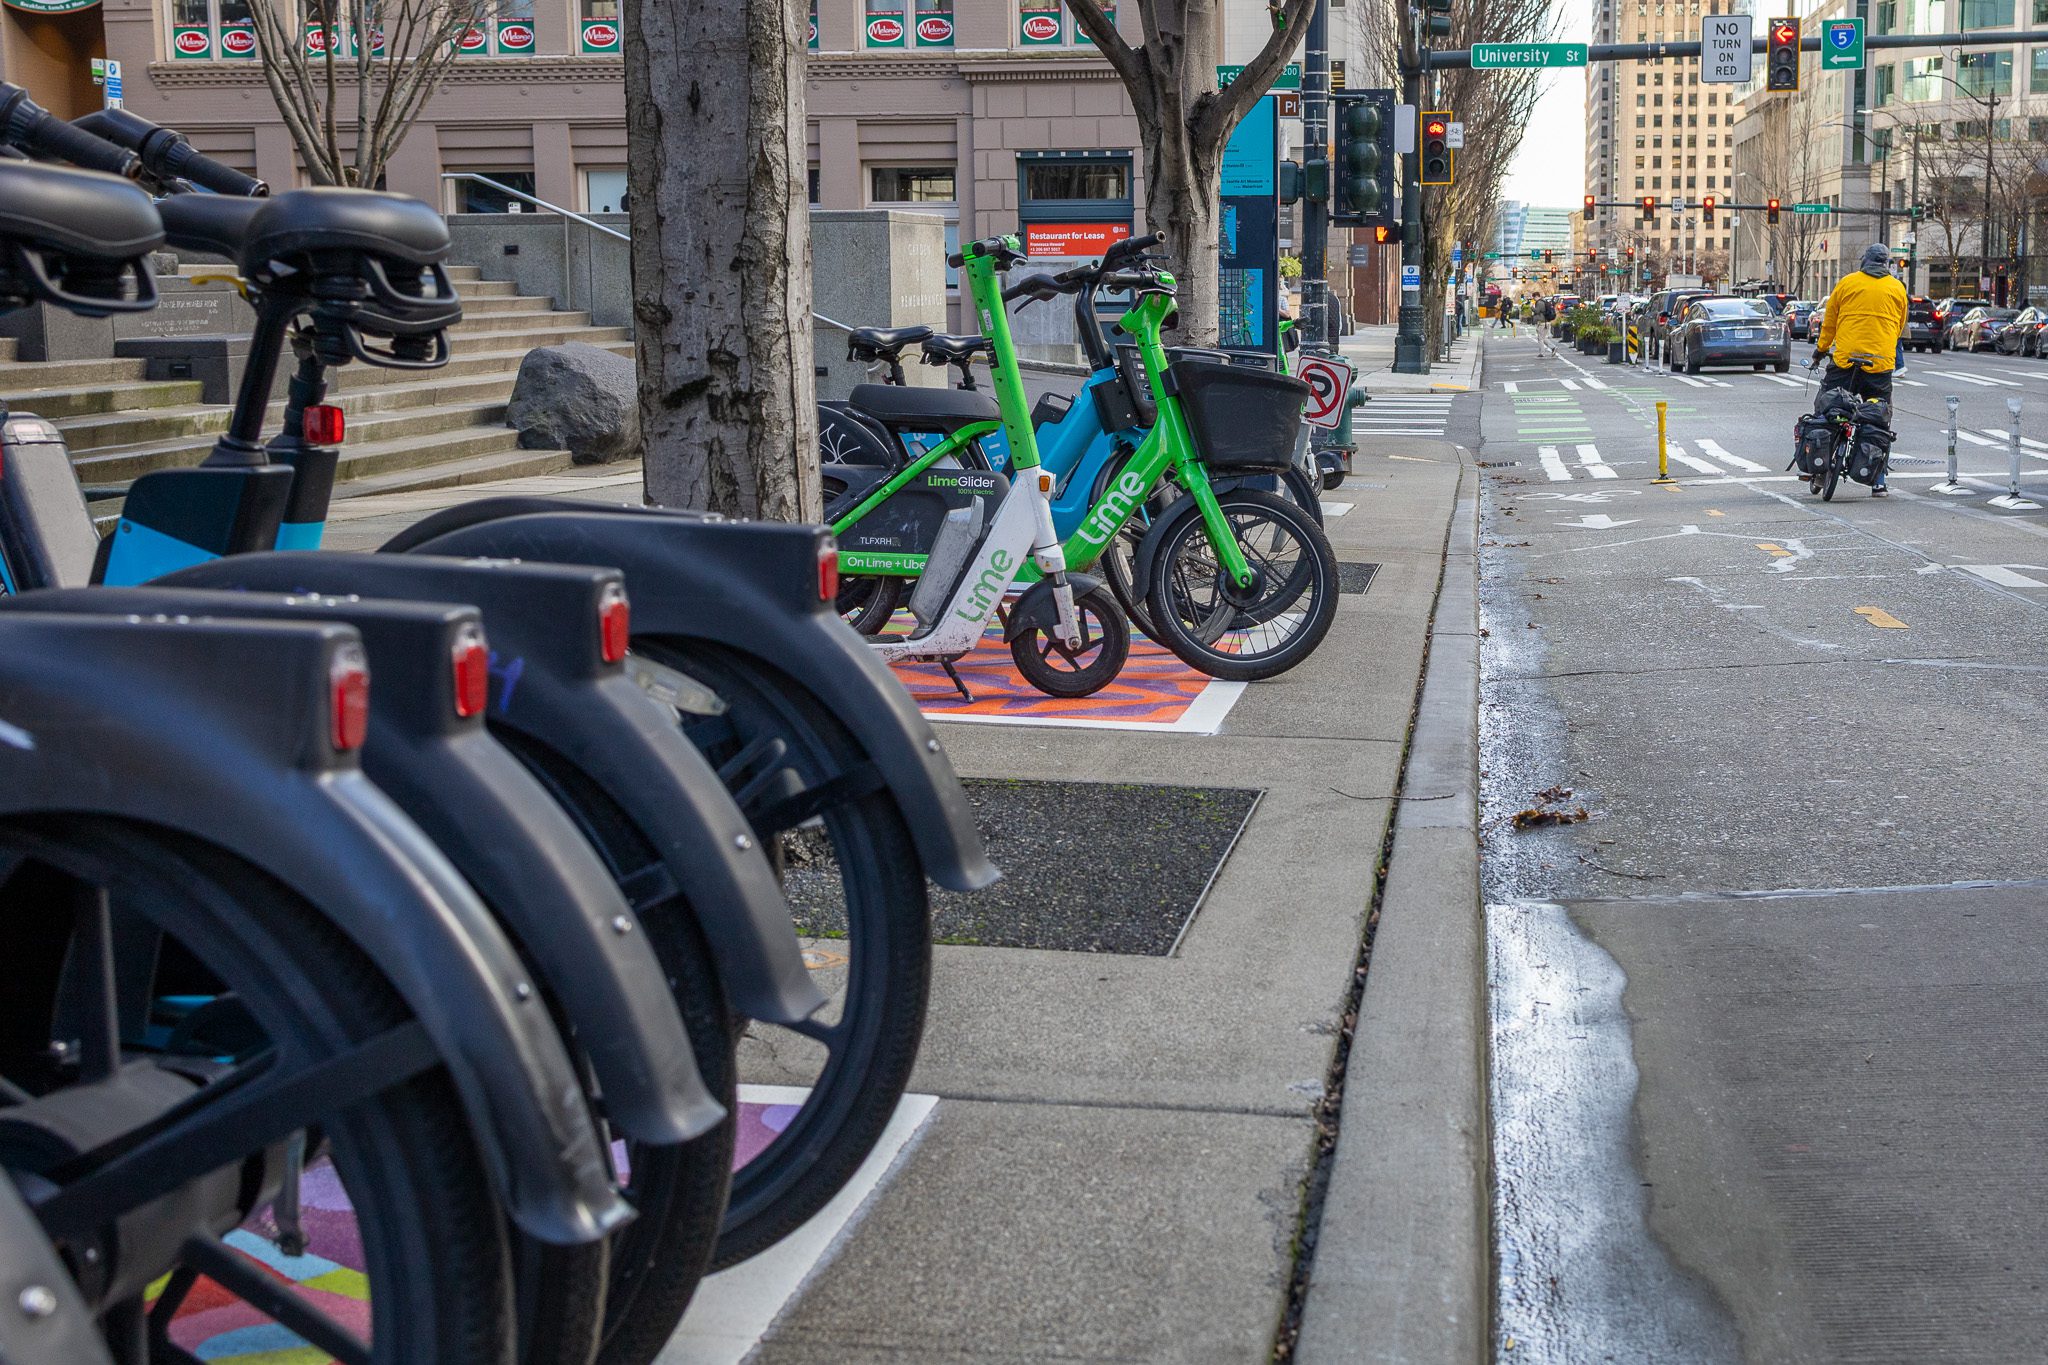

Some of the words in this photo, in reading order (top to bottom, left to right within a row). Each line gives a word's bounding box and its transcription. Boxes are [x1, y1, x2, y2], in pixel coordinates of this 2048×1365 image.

[870, 23, 901, 36] Melange
[920, 22, 950, 35] Melange
[1026, 20, 1056, 33] Melange
[1716, 22, 1739, 35] NO
[501, 30, 531, 42] Melange
[584, 28, 615, 41] Melange
[1838, 32, 1847, 46] 5
[177, 35, 206, 48] Melange
[225, 35, 254, 48] Melange
[1712, 39, 1741, 49] TURN
[1479, 48, 1550, 65] University
[1566, 50, 1580, 61] St
[1719, 53, 1734, 62] ON
[1282, 67, 1297, 76] 200
[1716, 66, 1737, 76] RED
[1030, 232, 1071, 240] Restaurant
[1071, 232, 1082, 240] for
[927, 475, 995, 488] LimeGlider
[973, 488, 994, 496] Electric
[1077, 471, 1145, 545] Lime
[847, 556, 864, 566] On
[866, 557, 893, 569] Lime
[903, 558, 925, 570] Ube
[954, 549, 1014, 622] Lime
